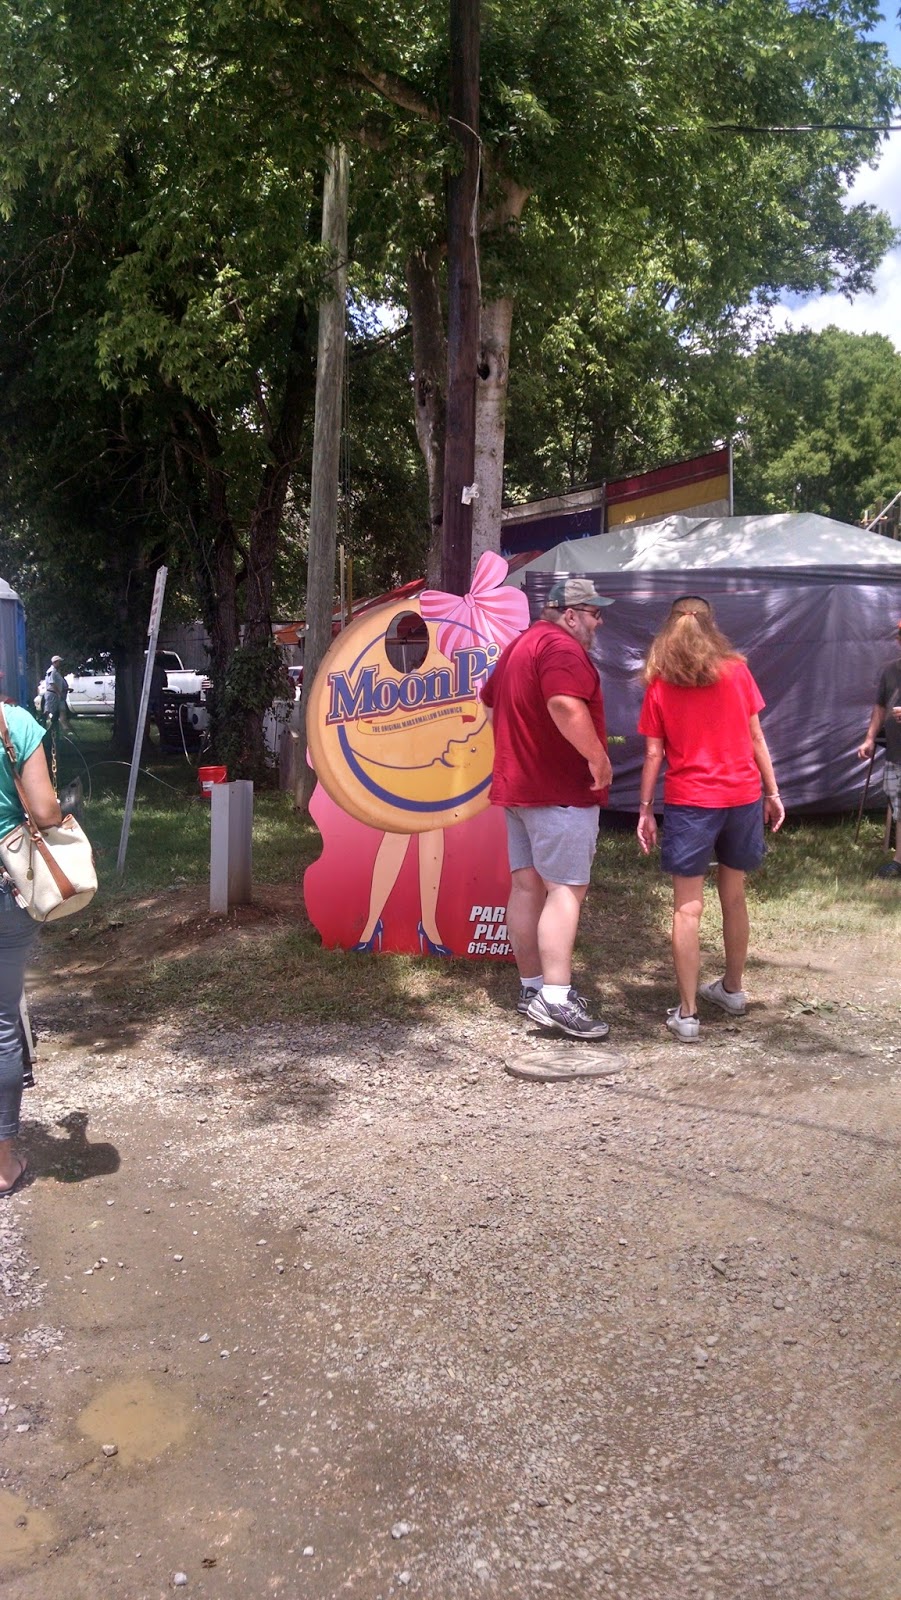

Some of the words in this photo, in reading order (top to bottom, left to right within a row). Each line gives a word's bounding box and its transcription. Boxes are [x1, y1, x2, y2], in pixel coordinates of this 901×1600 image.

[327, 643, 500, 724] MoonPi
[381, 723, 401, 732] ORIGINAL
[437, 706, 462, 717] SANDWICH
[469, 906, 506, 922] PAR
[473, 924, 509, 941] PLA
[467, 942, 514, 955] 615-641-
